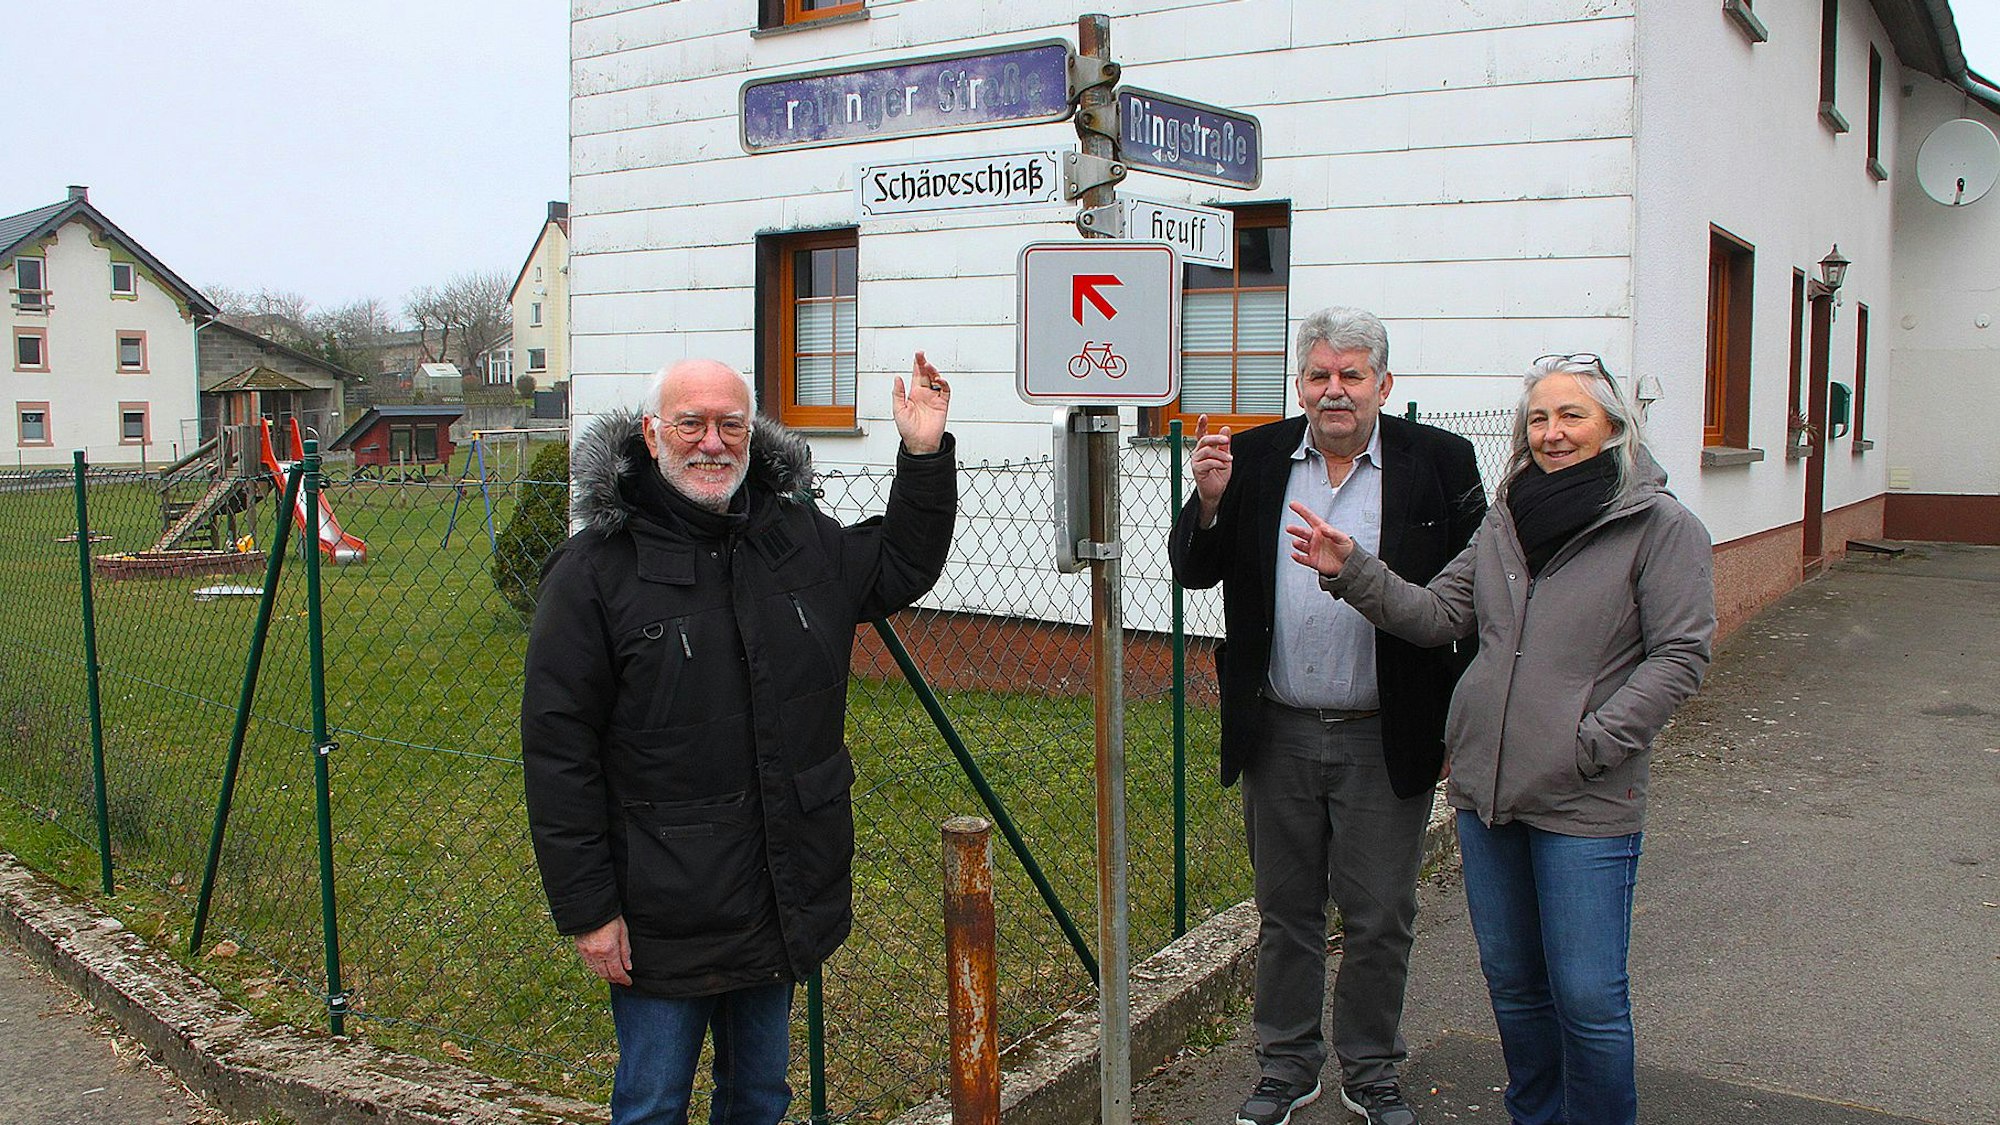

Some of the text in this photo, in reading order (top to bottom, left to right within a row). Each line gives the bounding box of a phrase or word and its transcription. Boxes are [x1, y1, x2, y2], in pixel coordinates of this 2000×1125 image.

[937, 61, 1043, 113] Straße
[1130, 97, 1248, 166] Ringstraße
[873, 158, 1044, 204] Schäveschjaß
